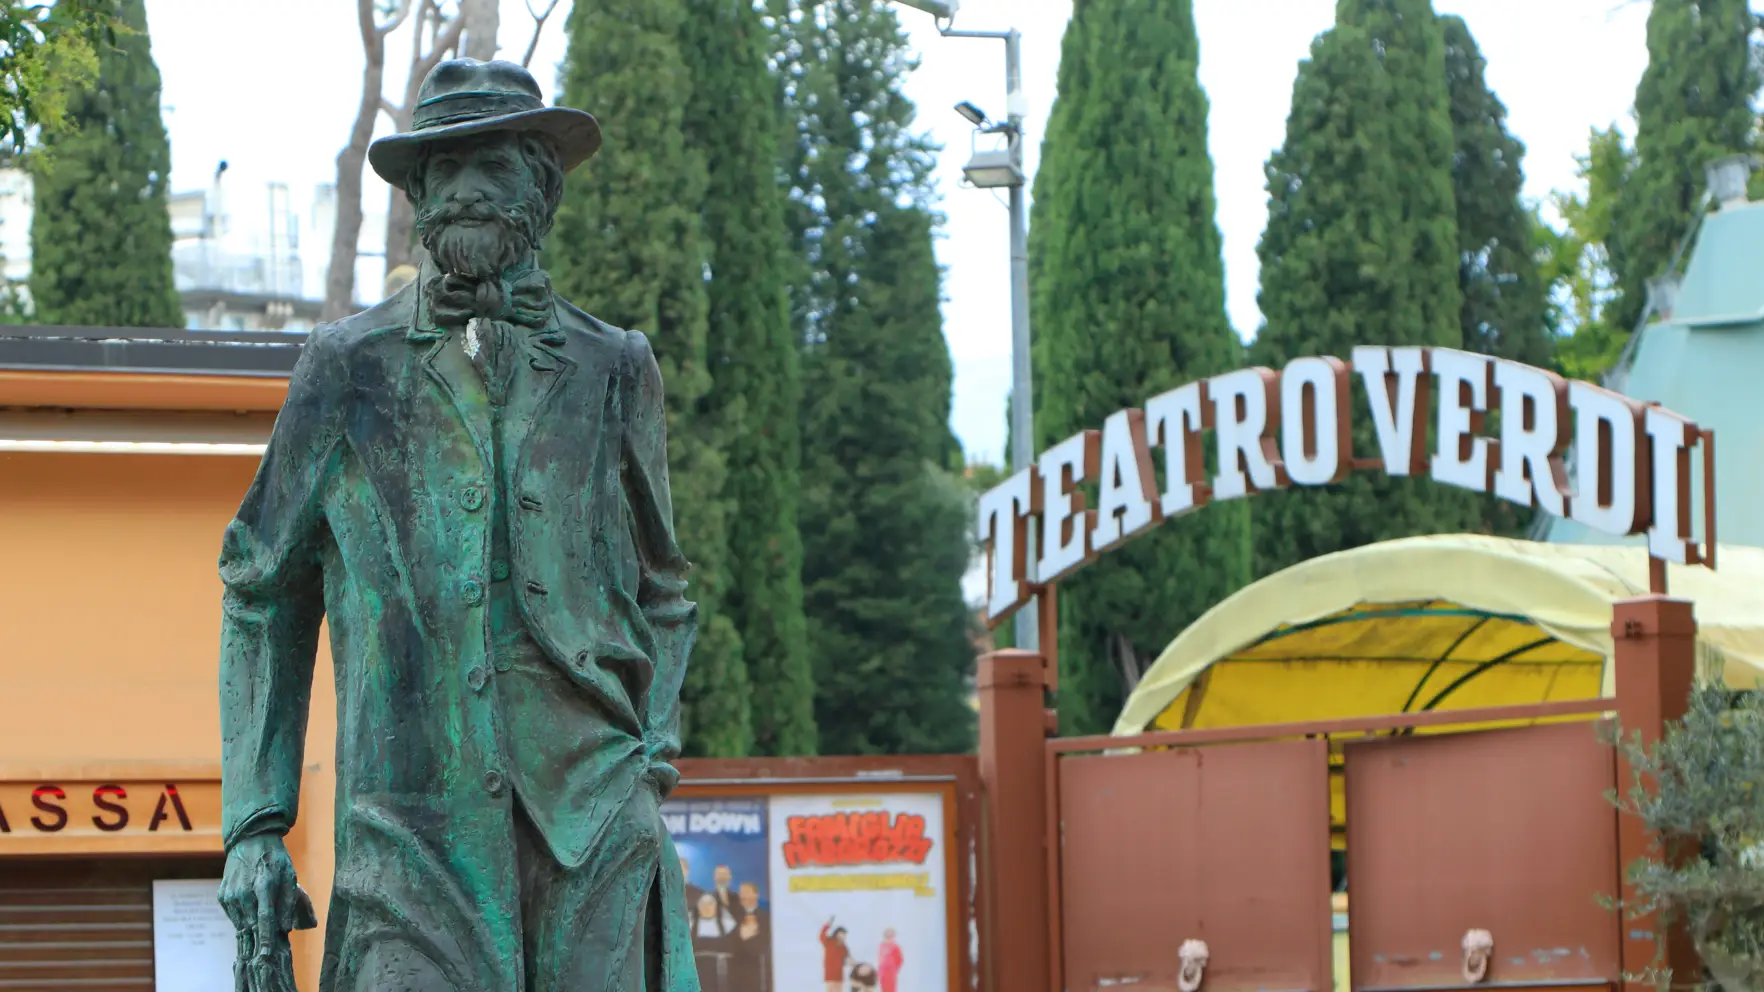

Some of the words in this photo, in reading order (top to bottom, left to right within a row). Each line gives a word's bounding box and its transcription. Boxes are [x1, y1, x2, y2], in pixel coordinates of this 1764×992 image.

[979, 356, 1343, 621] TEATRO
[1352, 345, 1696, 565] VERDI
[0, 783, 193, 833] SSA
[689, 812, 761, 835] DOWN
